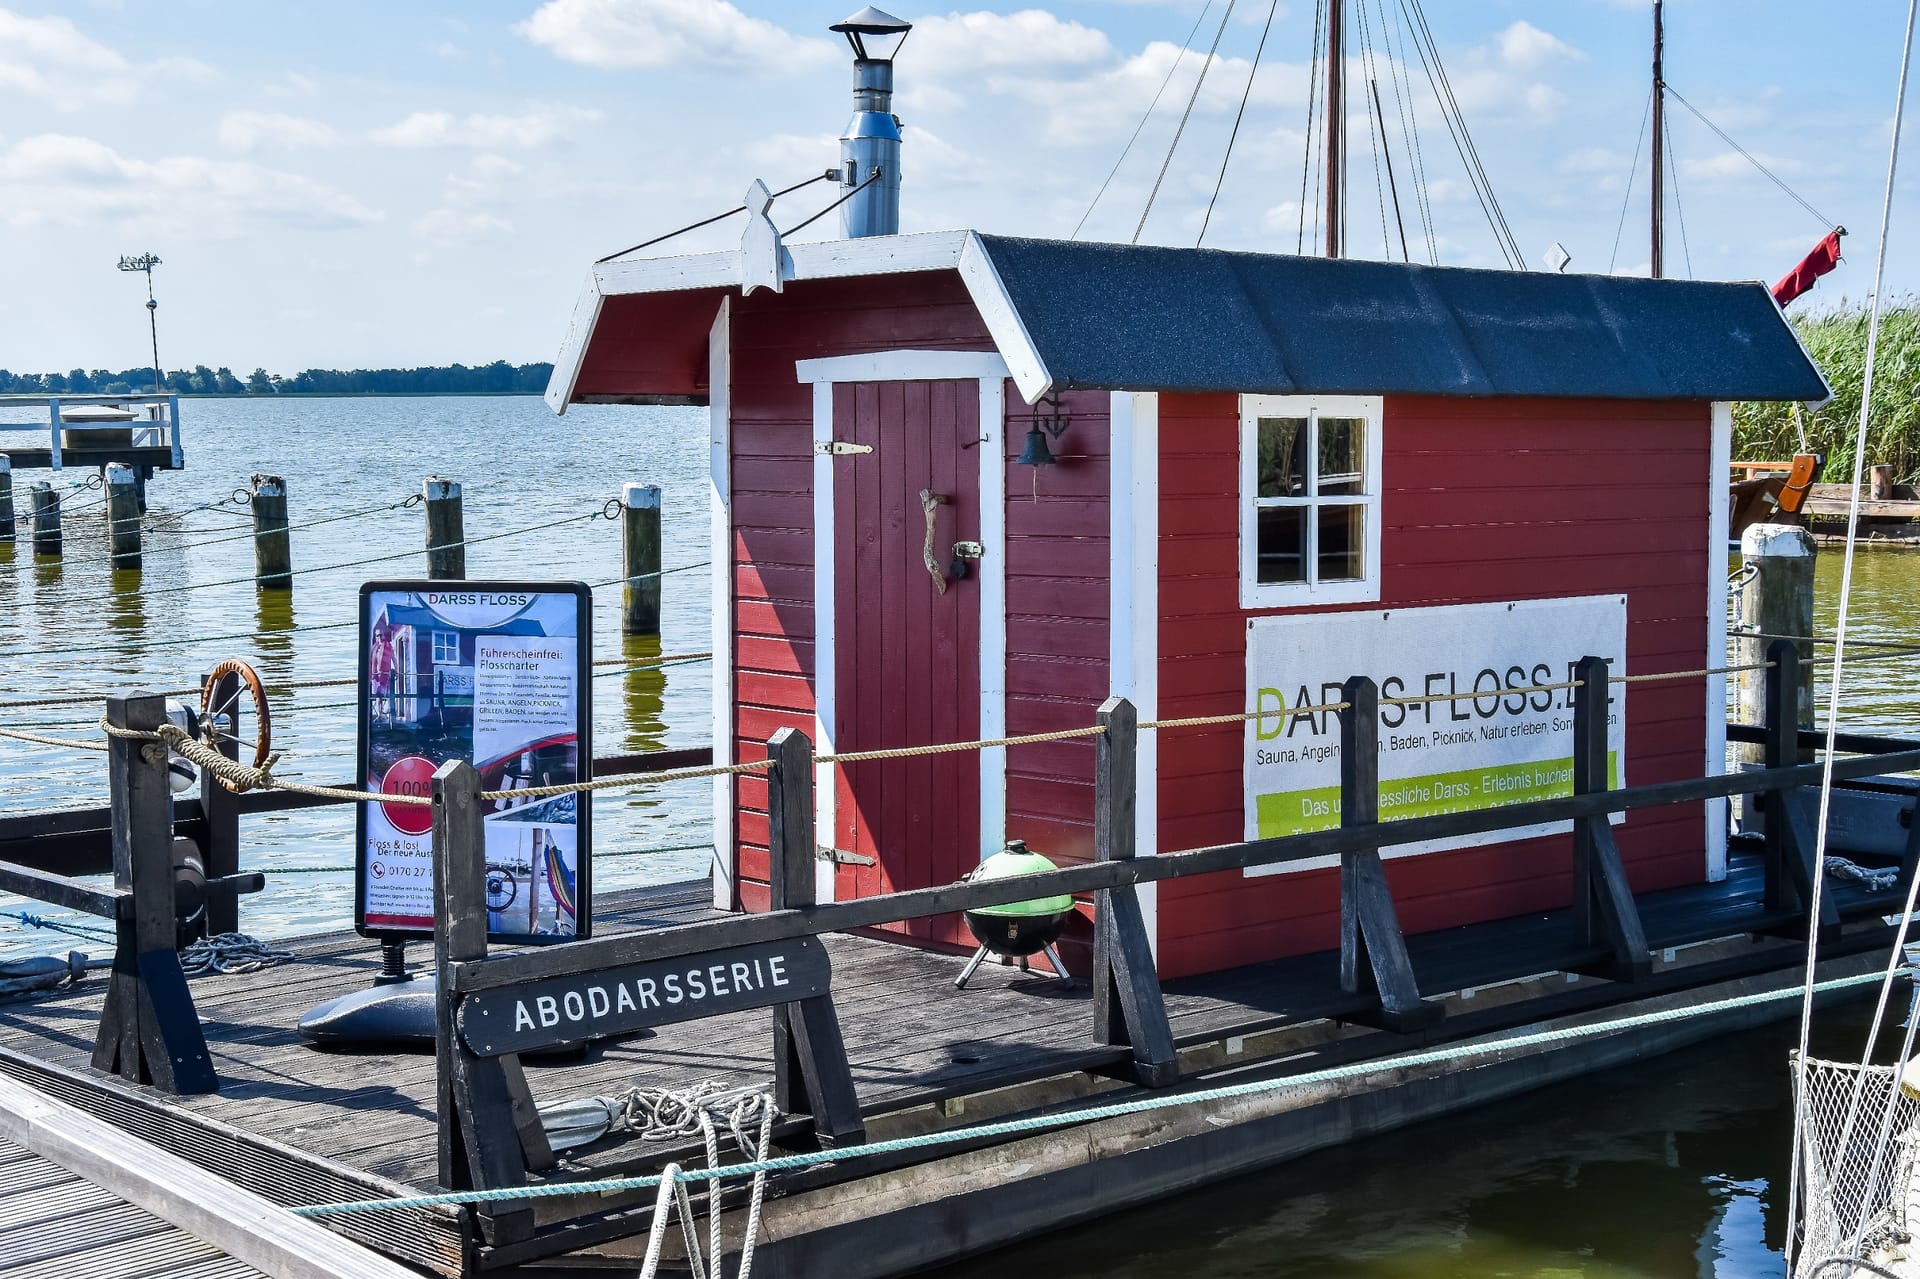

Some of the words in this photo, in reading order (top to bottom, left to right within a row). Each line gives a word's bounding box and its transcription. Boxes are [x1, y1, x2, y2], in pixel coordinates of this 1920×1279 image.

[429, 594, 476, 605] DARSS
[480, 595, 527, 606] FLOSS
[480, 648, 563, 660] Führerscheinfrei:
[480, 660, 539, 671] Flosscharter
[1257, 658, 1614, 741] DARS-FLOSS.
[1256, 749, 1298, 766] Sauna,
[1301, 742, 1340, 763] Angeln
[1390, 735, 1429, 751] Baden,
[1433, 728, 1477, 746] Picknick,
[1480, 725, 1508, 740] Natur
[1511, 721, 1549, 736] erleben,
[1302, 798, 1329, 817] Das
[1434, 781, 1470, 801] Darss
[1482, 770, 1531, 794] Erlebnis
[368, 839, 391, 849] Floss
[394, 840, 400, 849] &
[403, 840, 419, 850] los!
[377, 848, 391, 856] Der
[389, 866, 411, 876] 0170
[414, 867, 425, 877] 27
[515, 955, 789, 1033] ABODARSSERIE
